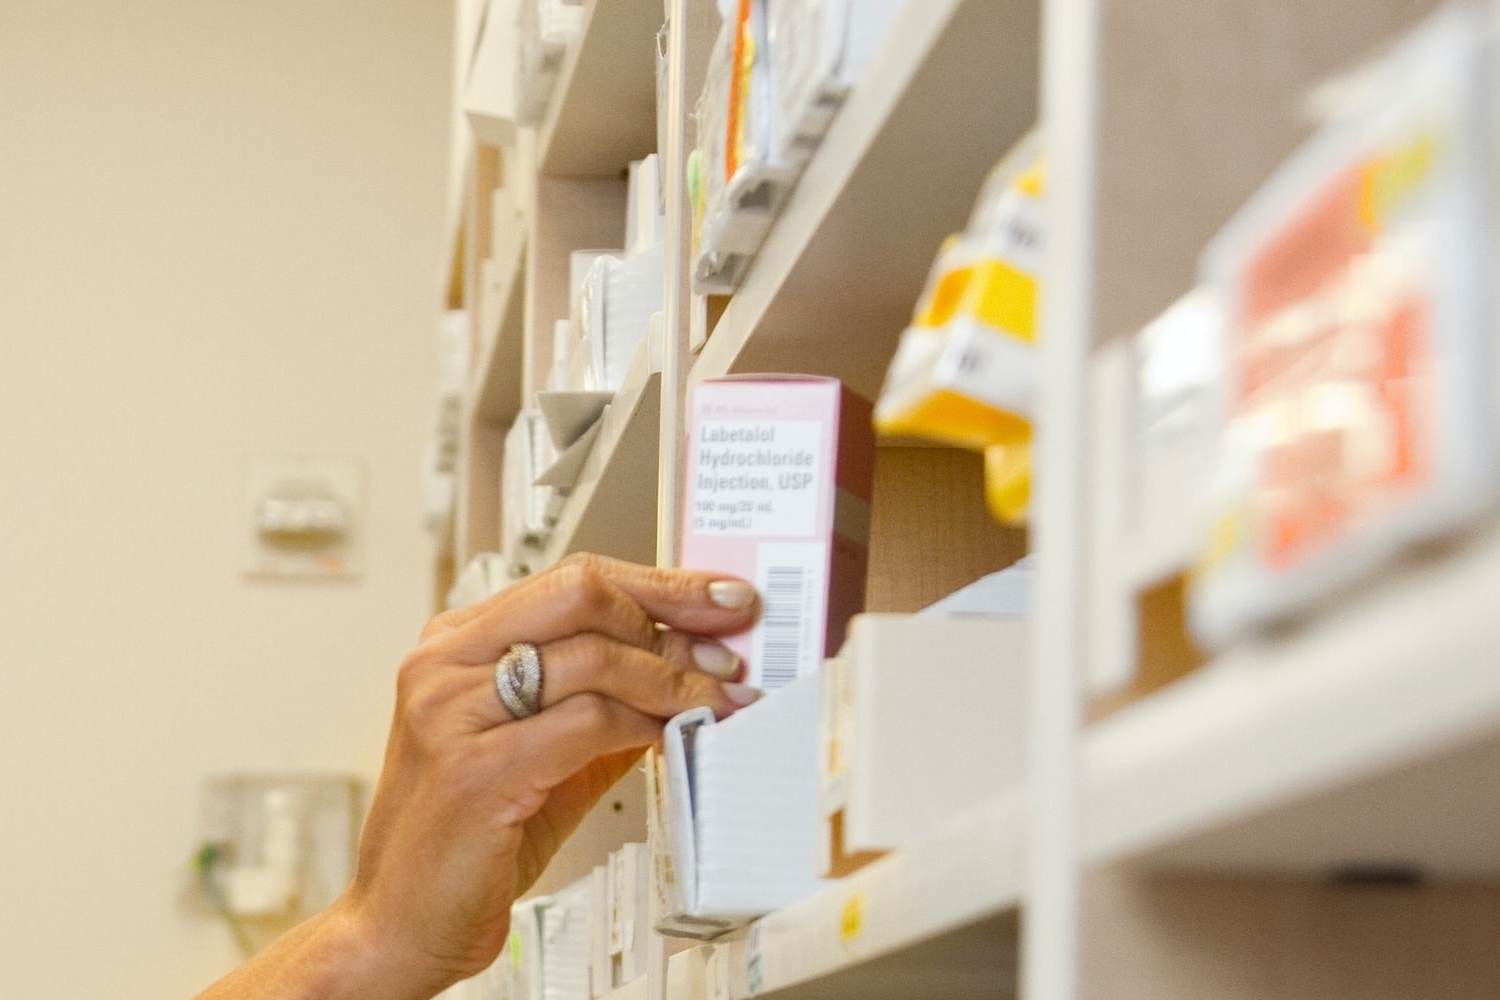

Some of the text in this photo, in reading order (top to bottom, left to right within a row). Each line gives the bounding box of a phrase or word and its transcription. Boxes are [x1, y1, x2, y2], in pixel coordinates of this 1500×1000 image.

[700, 424, 775, 442] Labetalol
[699, 447, 814, 470] Hydrochloride
[698, 471, 814, 494] Injection, USP
